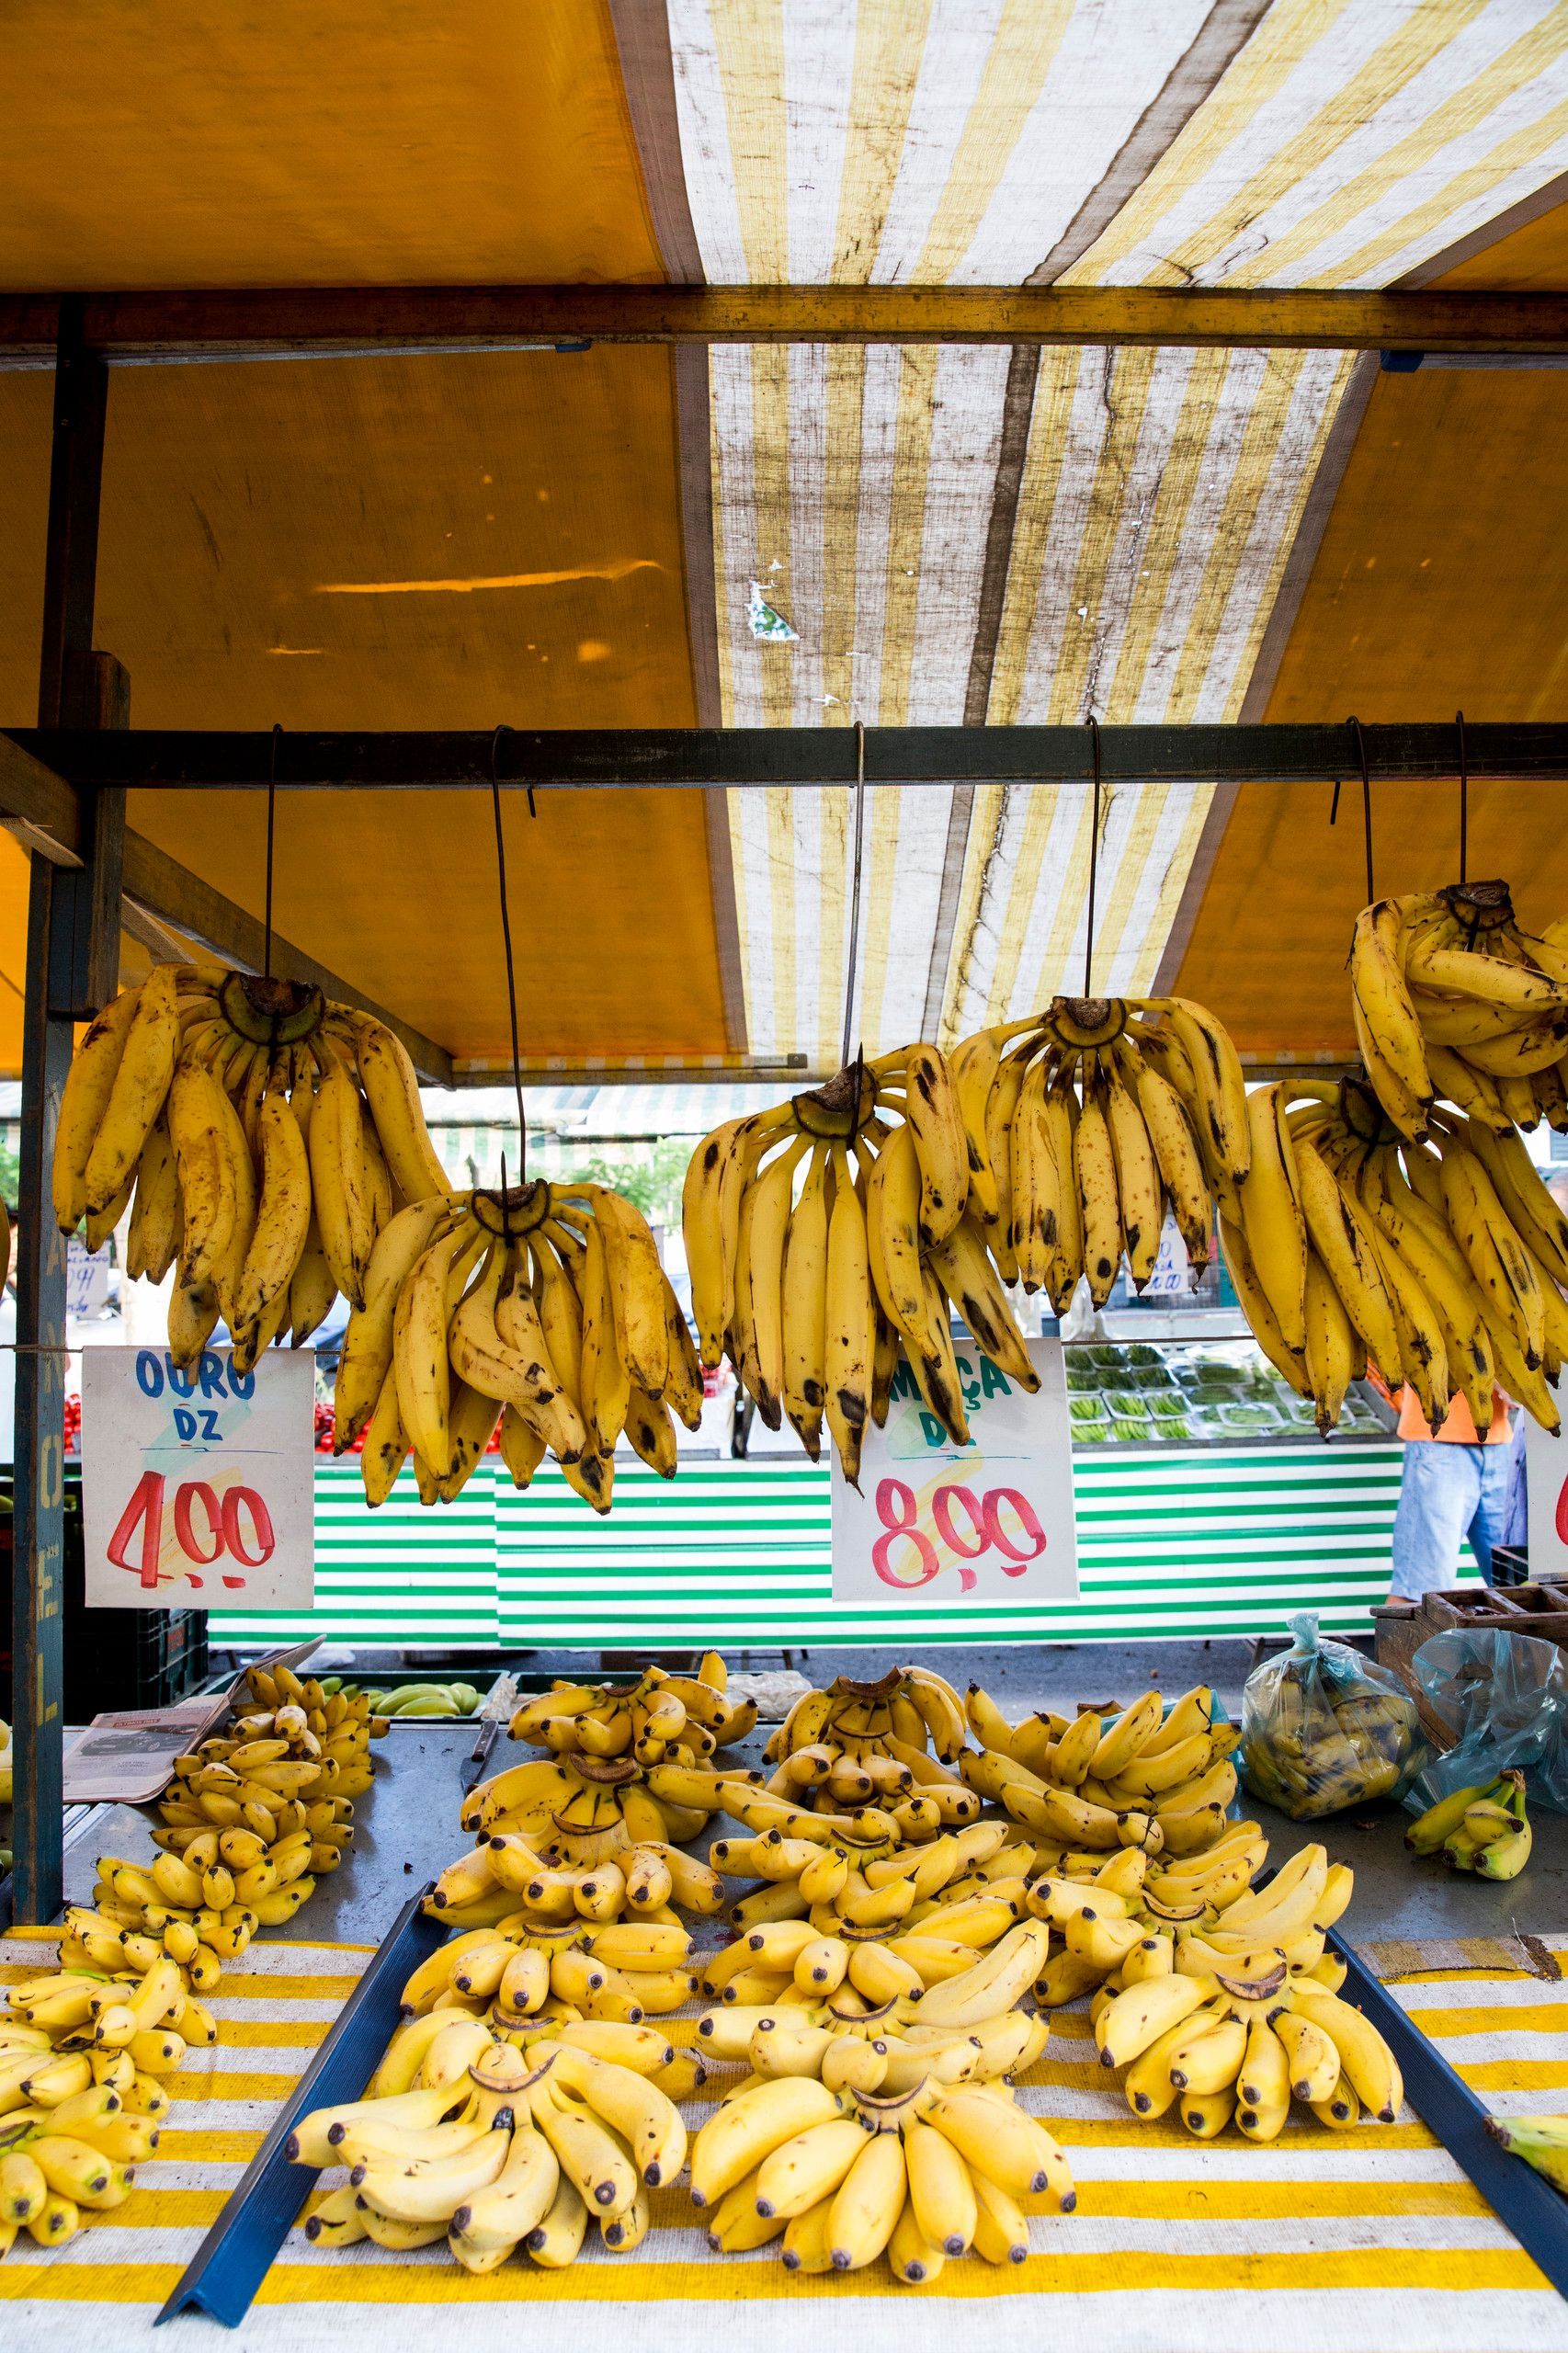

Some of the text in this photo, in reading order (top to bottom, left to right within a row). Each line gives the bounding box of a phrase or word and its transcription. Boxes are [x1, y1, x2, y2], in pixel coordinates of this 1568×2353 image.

[136, 1349, 256, 1400] OURO
[890, 1345, 1012, 1411] MÇÃ
[173, 1408, 223, 1441] DZ
[919, 1412, 977, 1448] D
